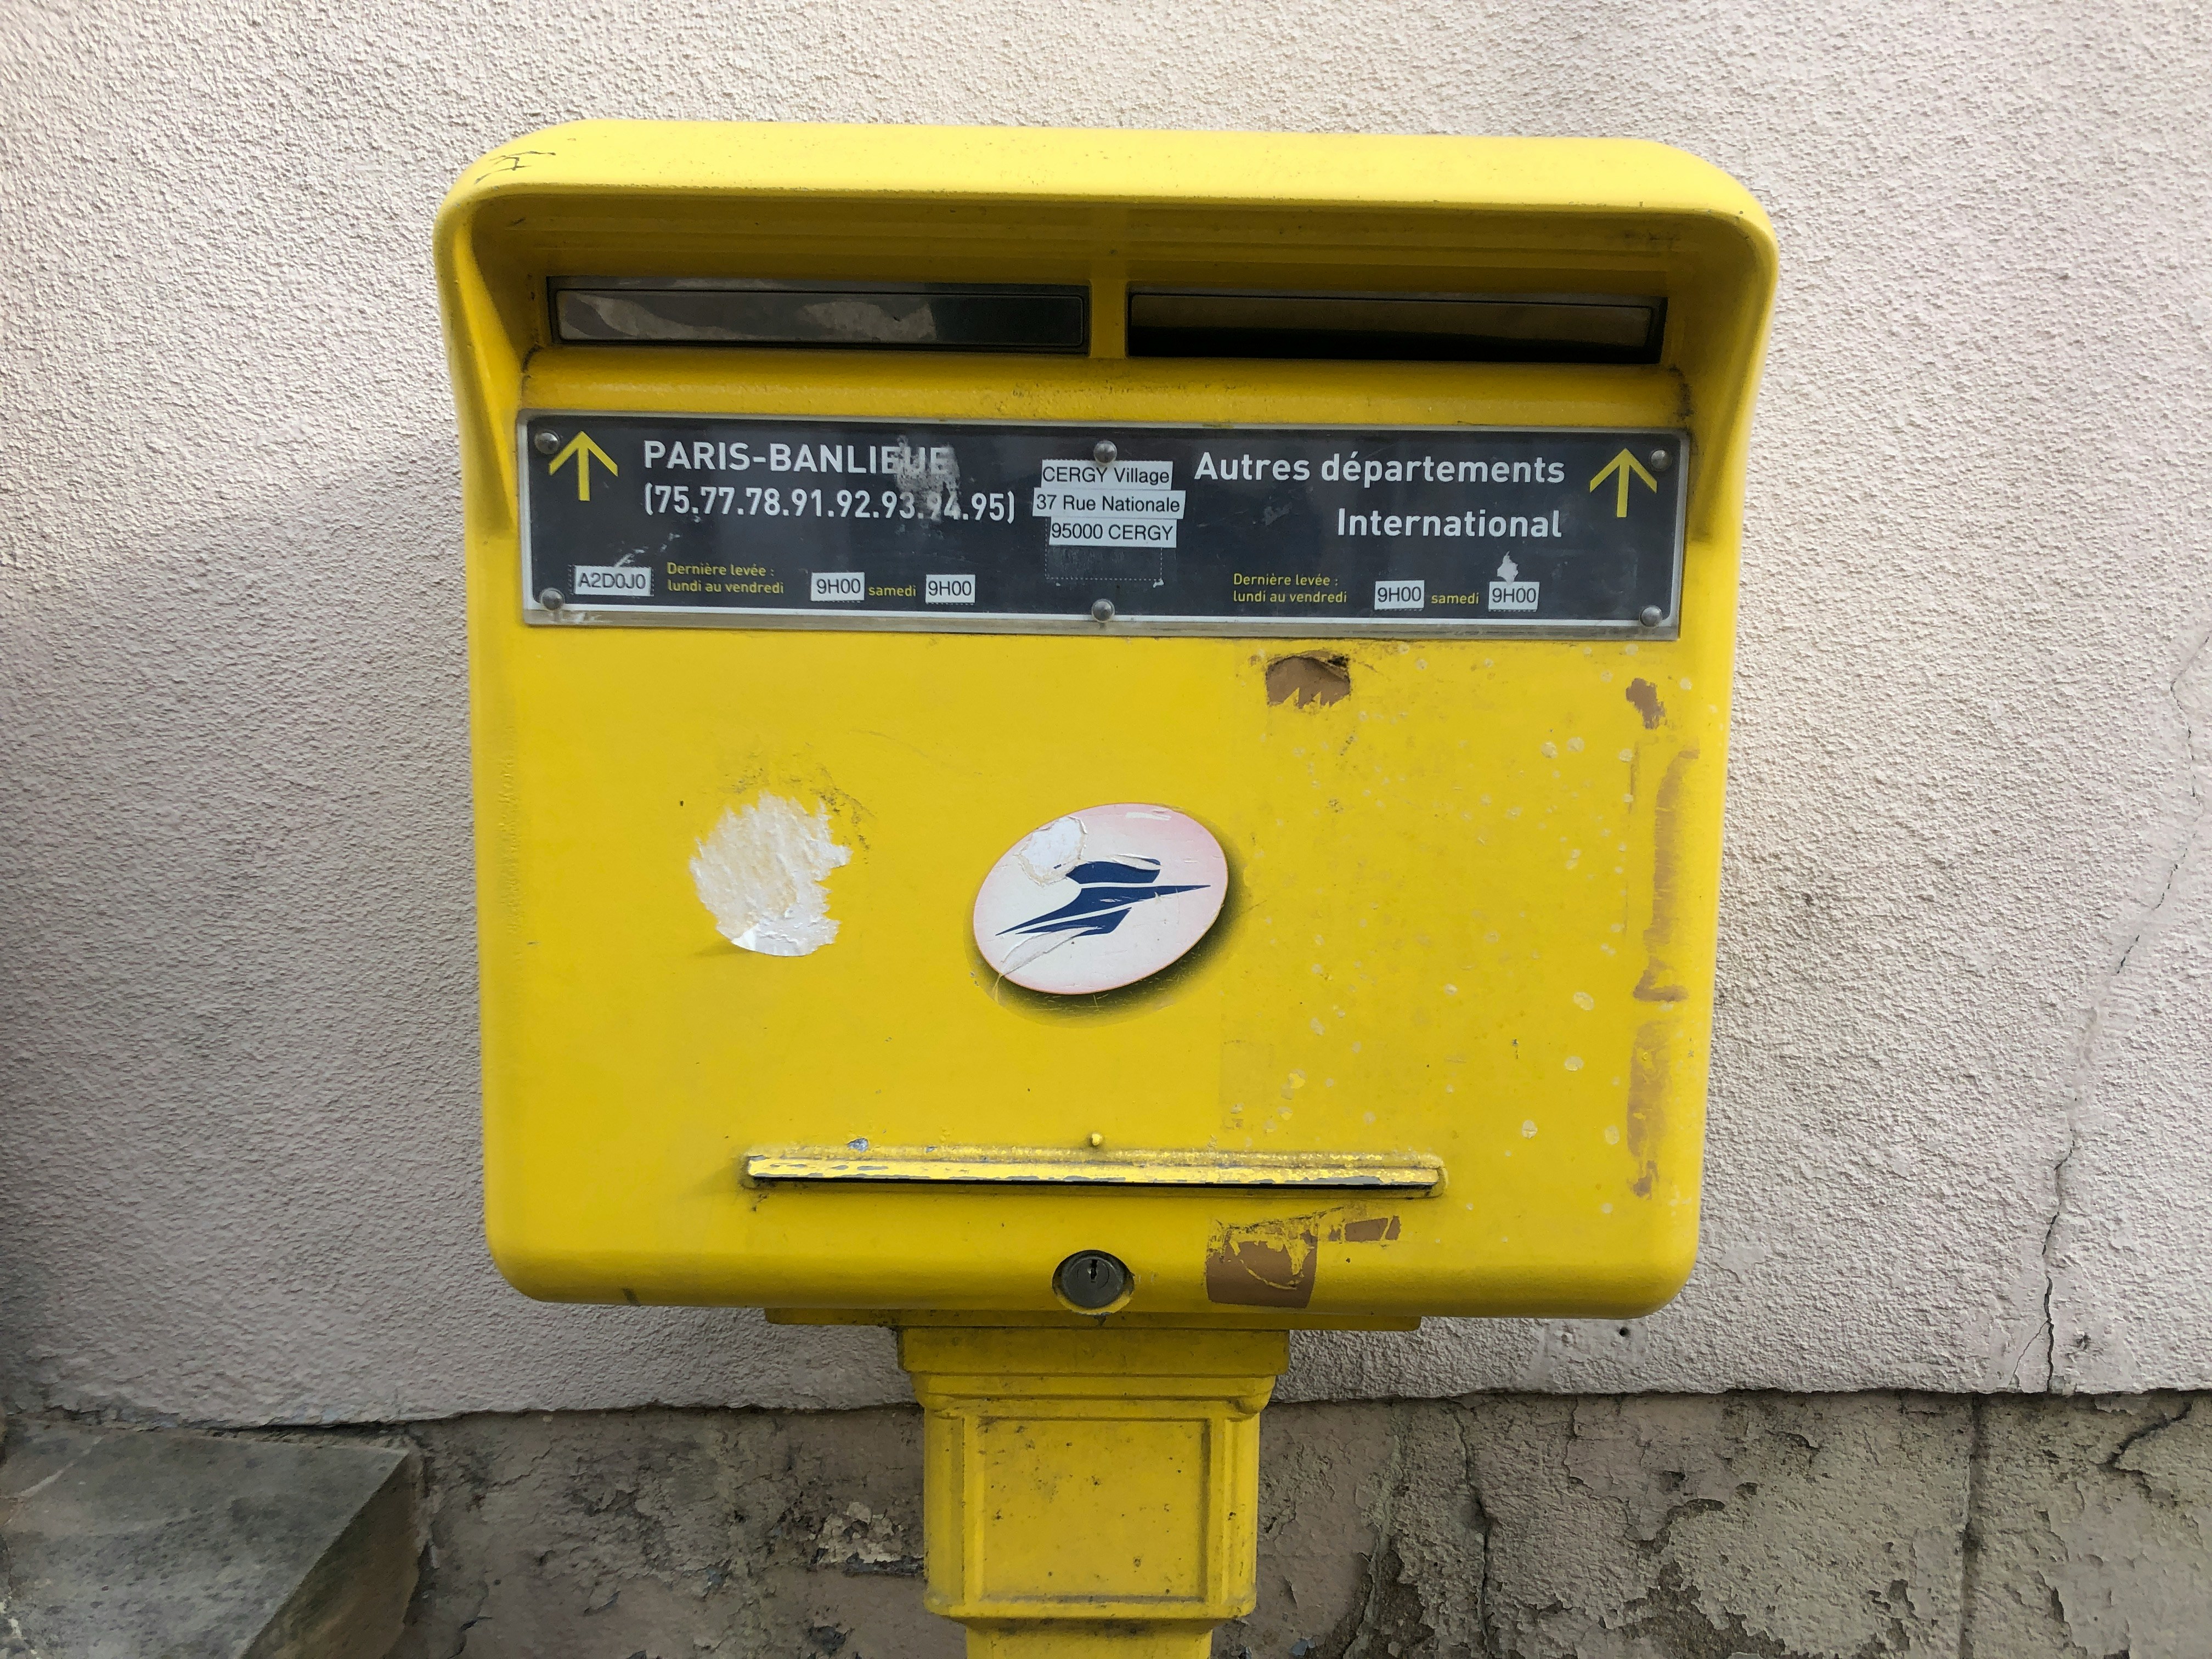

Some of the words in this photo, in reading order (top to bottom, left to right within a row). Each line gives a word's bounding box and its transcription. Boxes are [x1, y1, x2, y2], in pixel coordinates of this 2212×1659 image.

[644, 439, 953, 475] PARIS-BANLIEUE
[1042, 465, 1107, 483] CERGY
[1114, 466, 1170, 486] Village
[1194, 451, 1311, 482] Autres
[1321, 450, 1565, 488] départements
[644, 482, 1015, 524] (75.77.78.91.92.93.94.95)
[1036, 494, 1057, 510] 37
[1063, 495, 1096, 511] Rue
[1102, 496, 1181, 513] Nationale
[1052, 522, 1103, 539] 95000
[1108, 524, 1173, 541] CERGY
[1338, 507, 1562, 538] International
[667, 561, 727, 575] Dernière
[730, 563, 766, 577] levée
[667, 579, 702, 592] lundi
[704, 583, 721, 592] au
[724, 581, 785, 594] vendredi
[816, 578, 861, 595] 9H00
[868, 584, 917, 597] samedi
[928, 580, 972, 596] 9H00
[1233, 573, 1291, 586] Dernière
[1295, 573, 1330, 586] levée
[1233, 590, 1266, 602] lundi
[1269, 593, 1285, 603] au
[1289, 591, 1348, 603] vendredi
[1377, 586, 1423, 603] 9H00
[1430, 591, 1480, 605] samedi
[1492, 588, 1537, 605] 9H00
